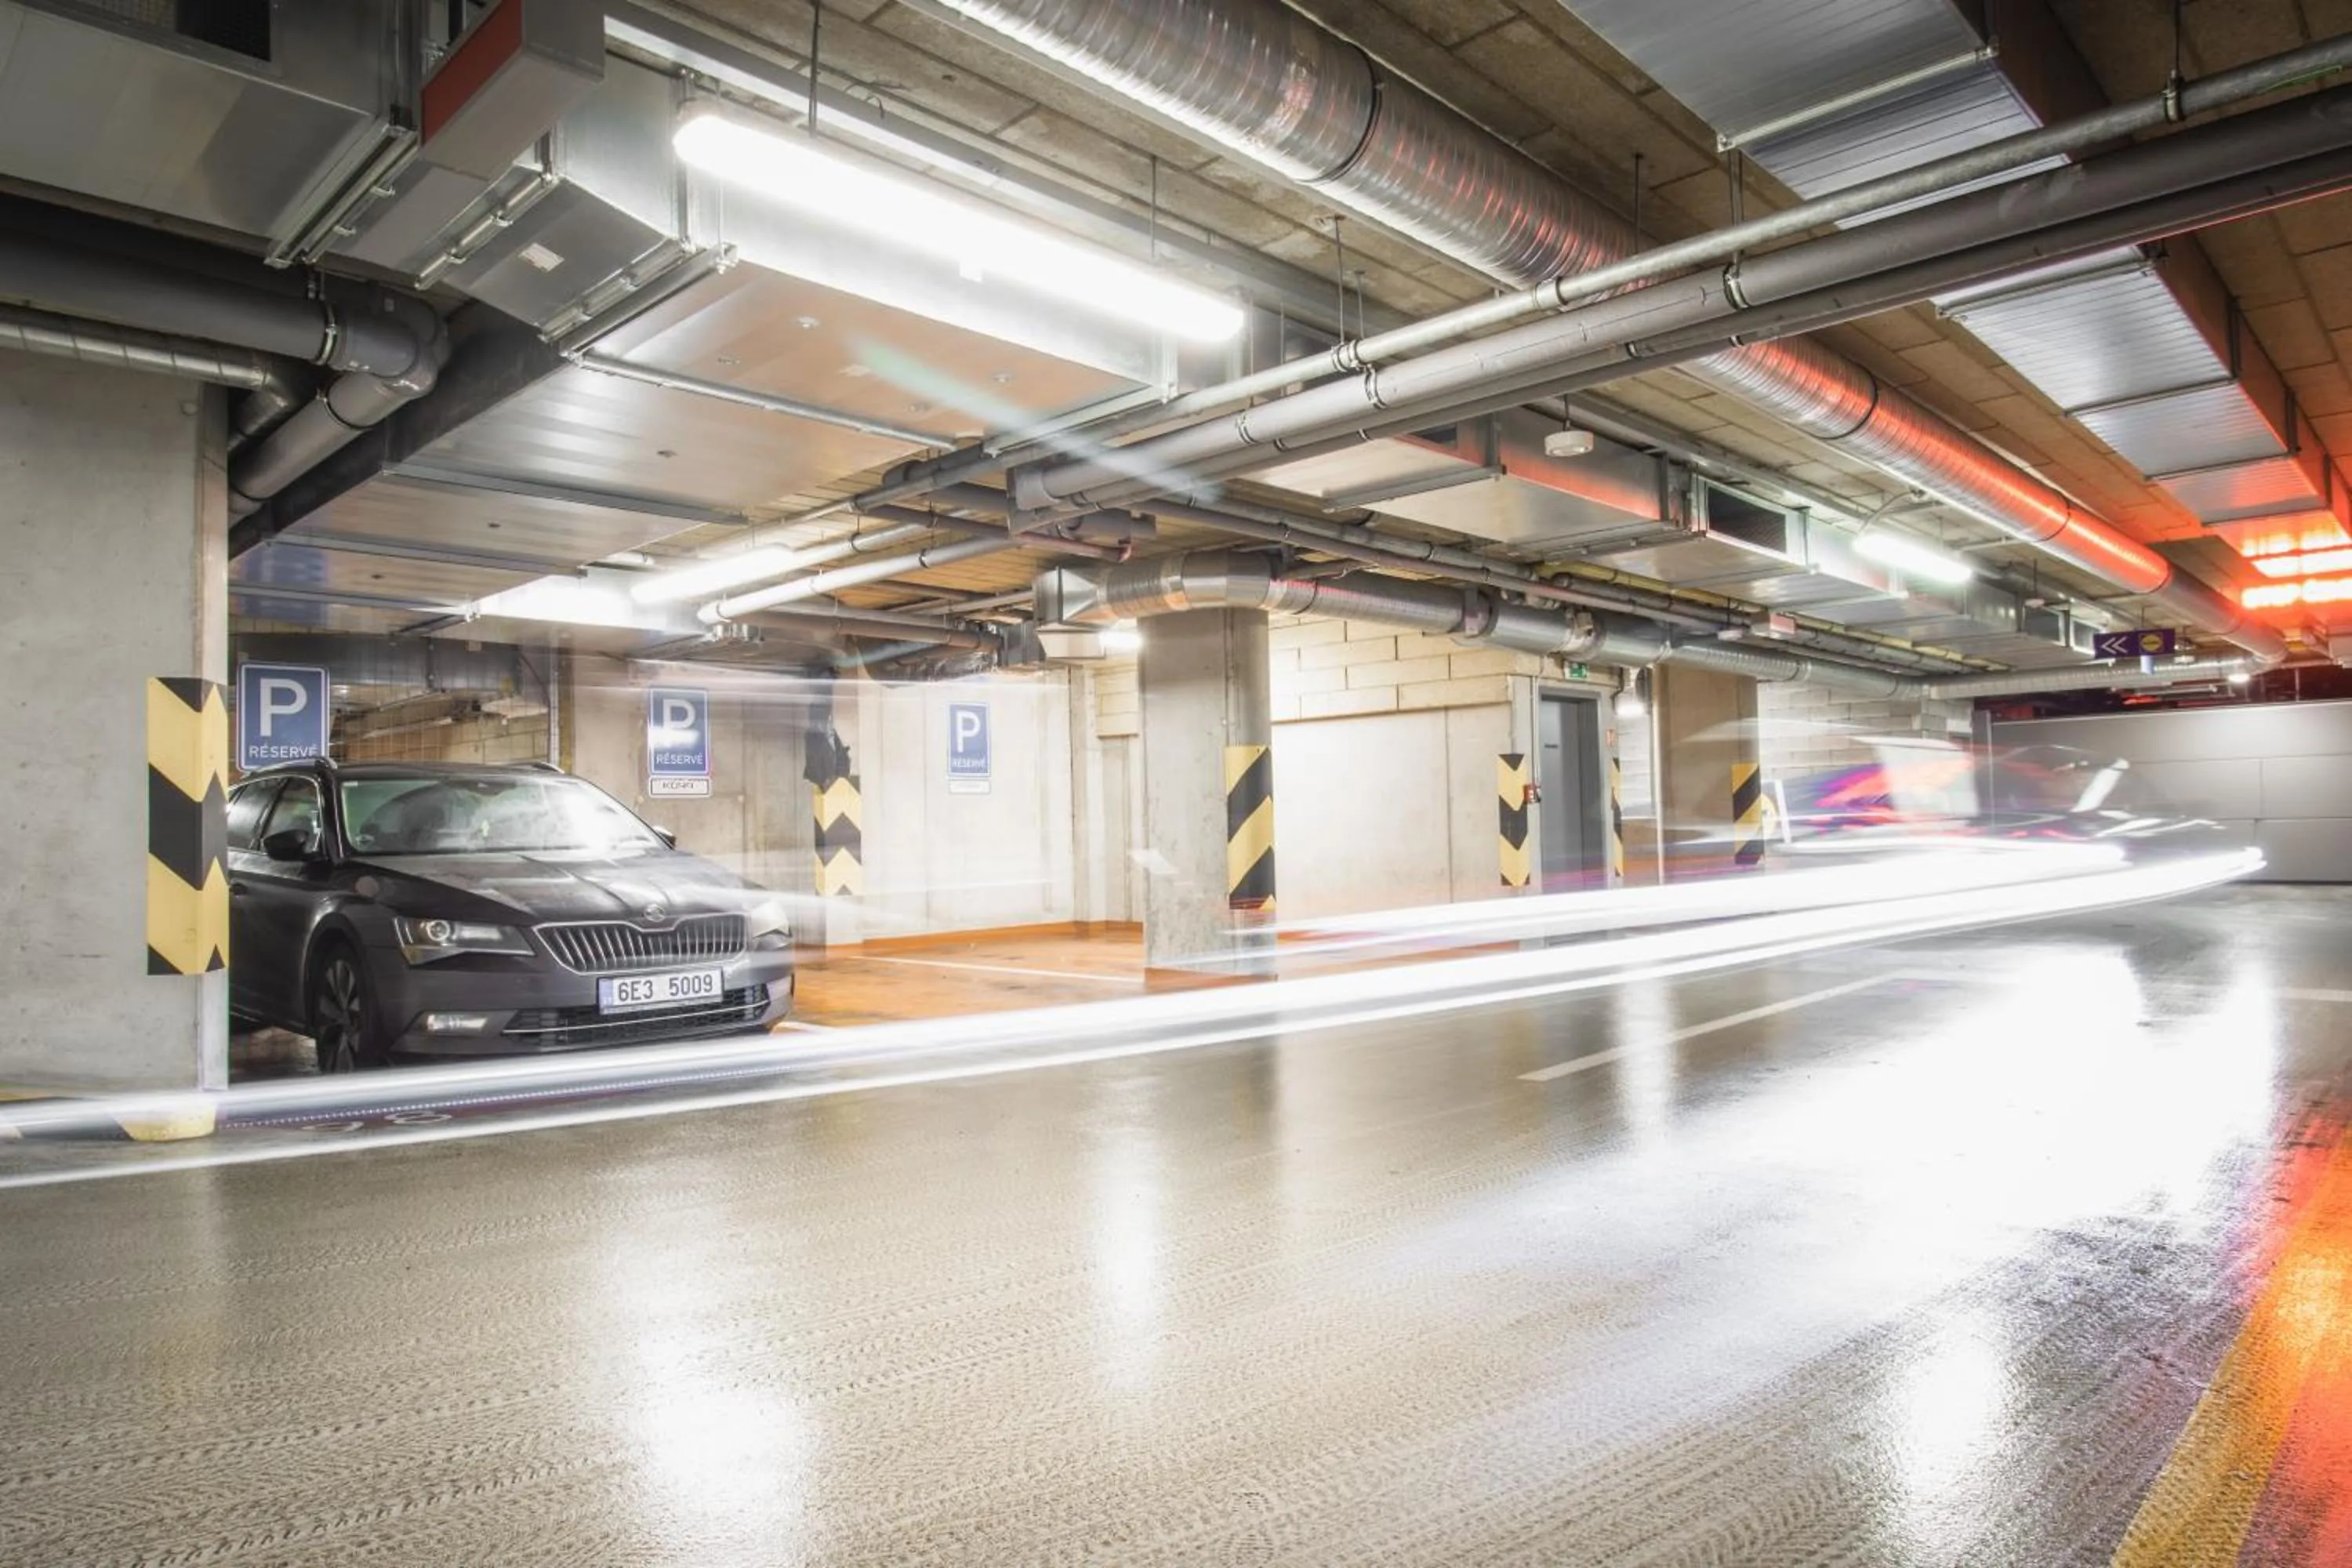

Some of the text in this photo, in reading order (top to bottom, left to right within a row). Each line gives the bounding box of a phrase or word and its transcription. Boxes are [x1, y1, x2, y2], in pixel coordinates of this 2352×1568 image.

[260, 677, 307, 737] P
[663, 699, 696, 746] P
[249, 741, 318, 758] RÉSERVÉ
[956, 711, 981, 753] P
[655, 752, 703, 764] RÉSERVÉ
[618, 979, 653, 1002] 6E3
[669, 974, 713, 996] 5009
